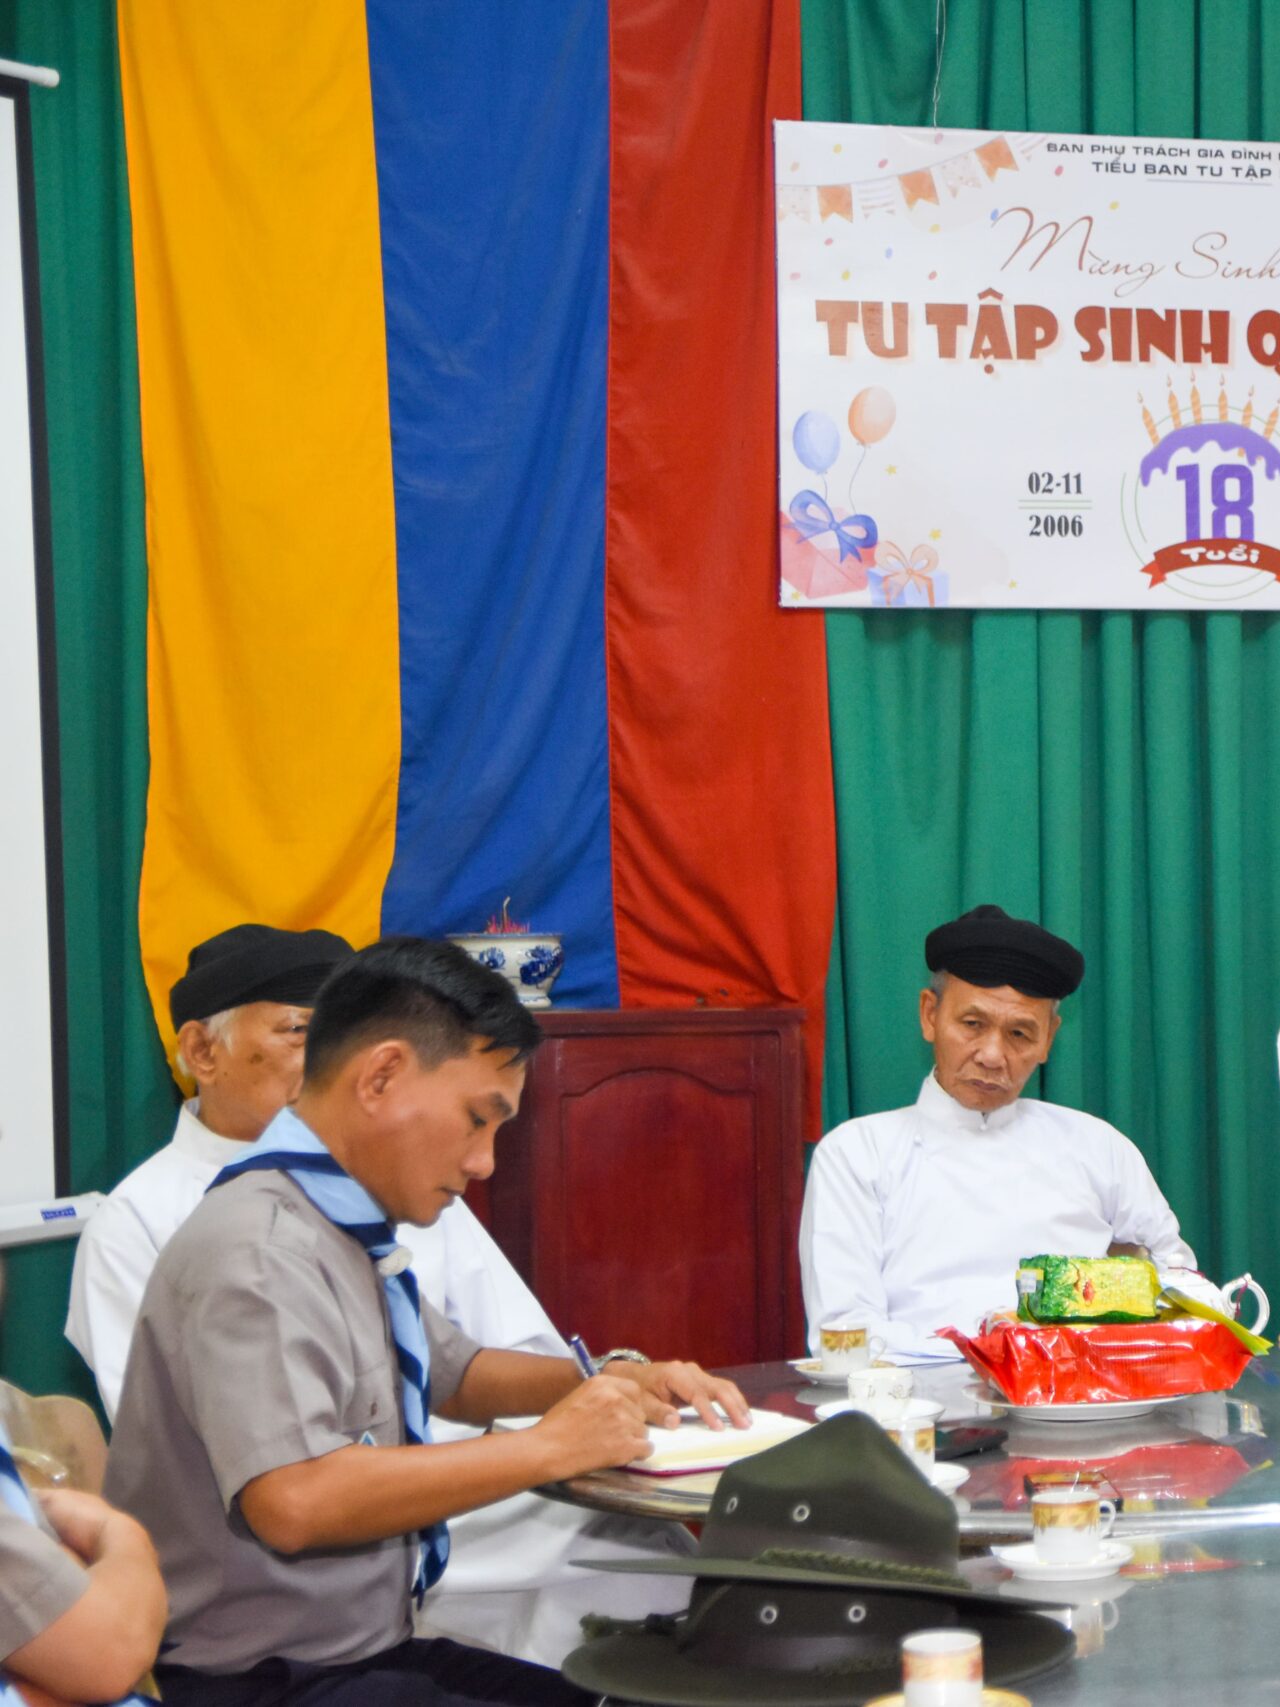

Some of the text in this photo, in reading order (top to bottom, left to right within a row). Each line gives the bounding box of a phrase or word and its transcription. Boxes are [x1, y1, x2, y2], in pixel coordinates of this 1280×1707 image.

[1047, 142, 1084, 153] BAN
[1090, 144, 1126, 157] PHỤ
[1132, 144, 1191, 157] TRÁCH
[1197, 148, 1225, 159] GIA
[1092, 156, 1136, 174] TIỂU
[1144, 163, 1187, 176] BAN
[1196, 165, 1223, 177] TU
[1231, 164, 1272, 181] TẬP
[991, 207, 1163, 298] Mừng
[815, 300, 909, 360] TU
[925, 287, 1059, 375] TẬP
[1074, 305, 1230, 365] SINH
[1027, 471, 1083, 496] 02-11
[1175, 463, 1255, 542] 18
[1028, 515, 1084, 538] 2006
[1179, 543, 1261, 564] Tuổi
